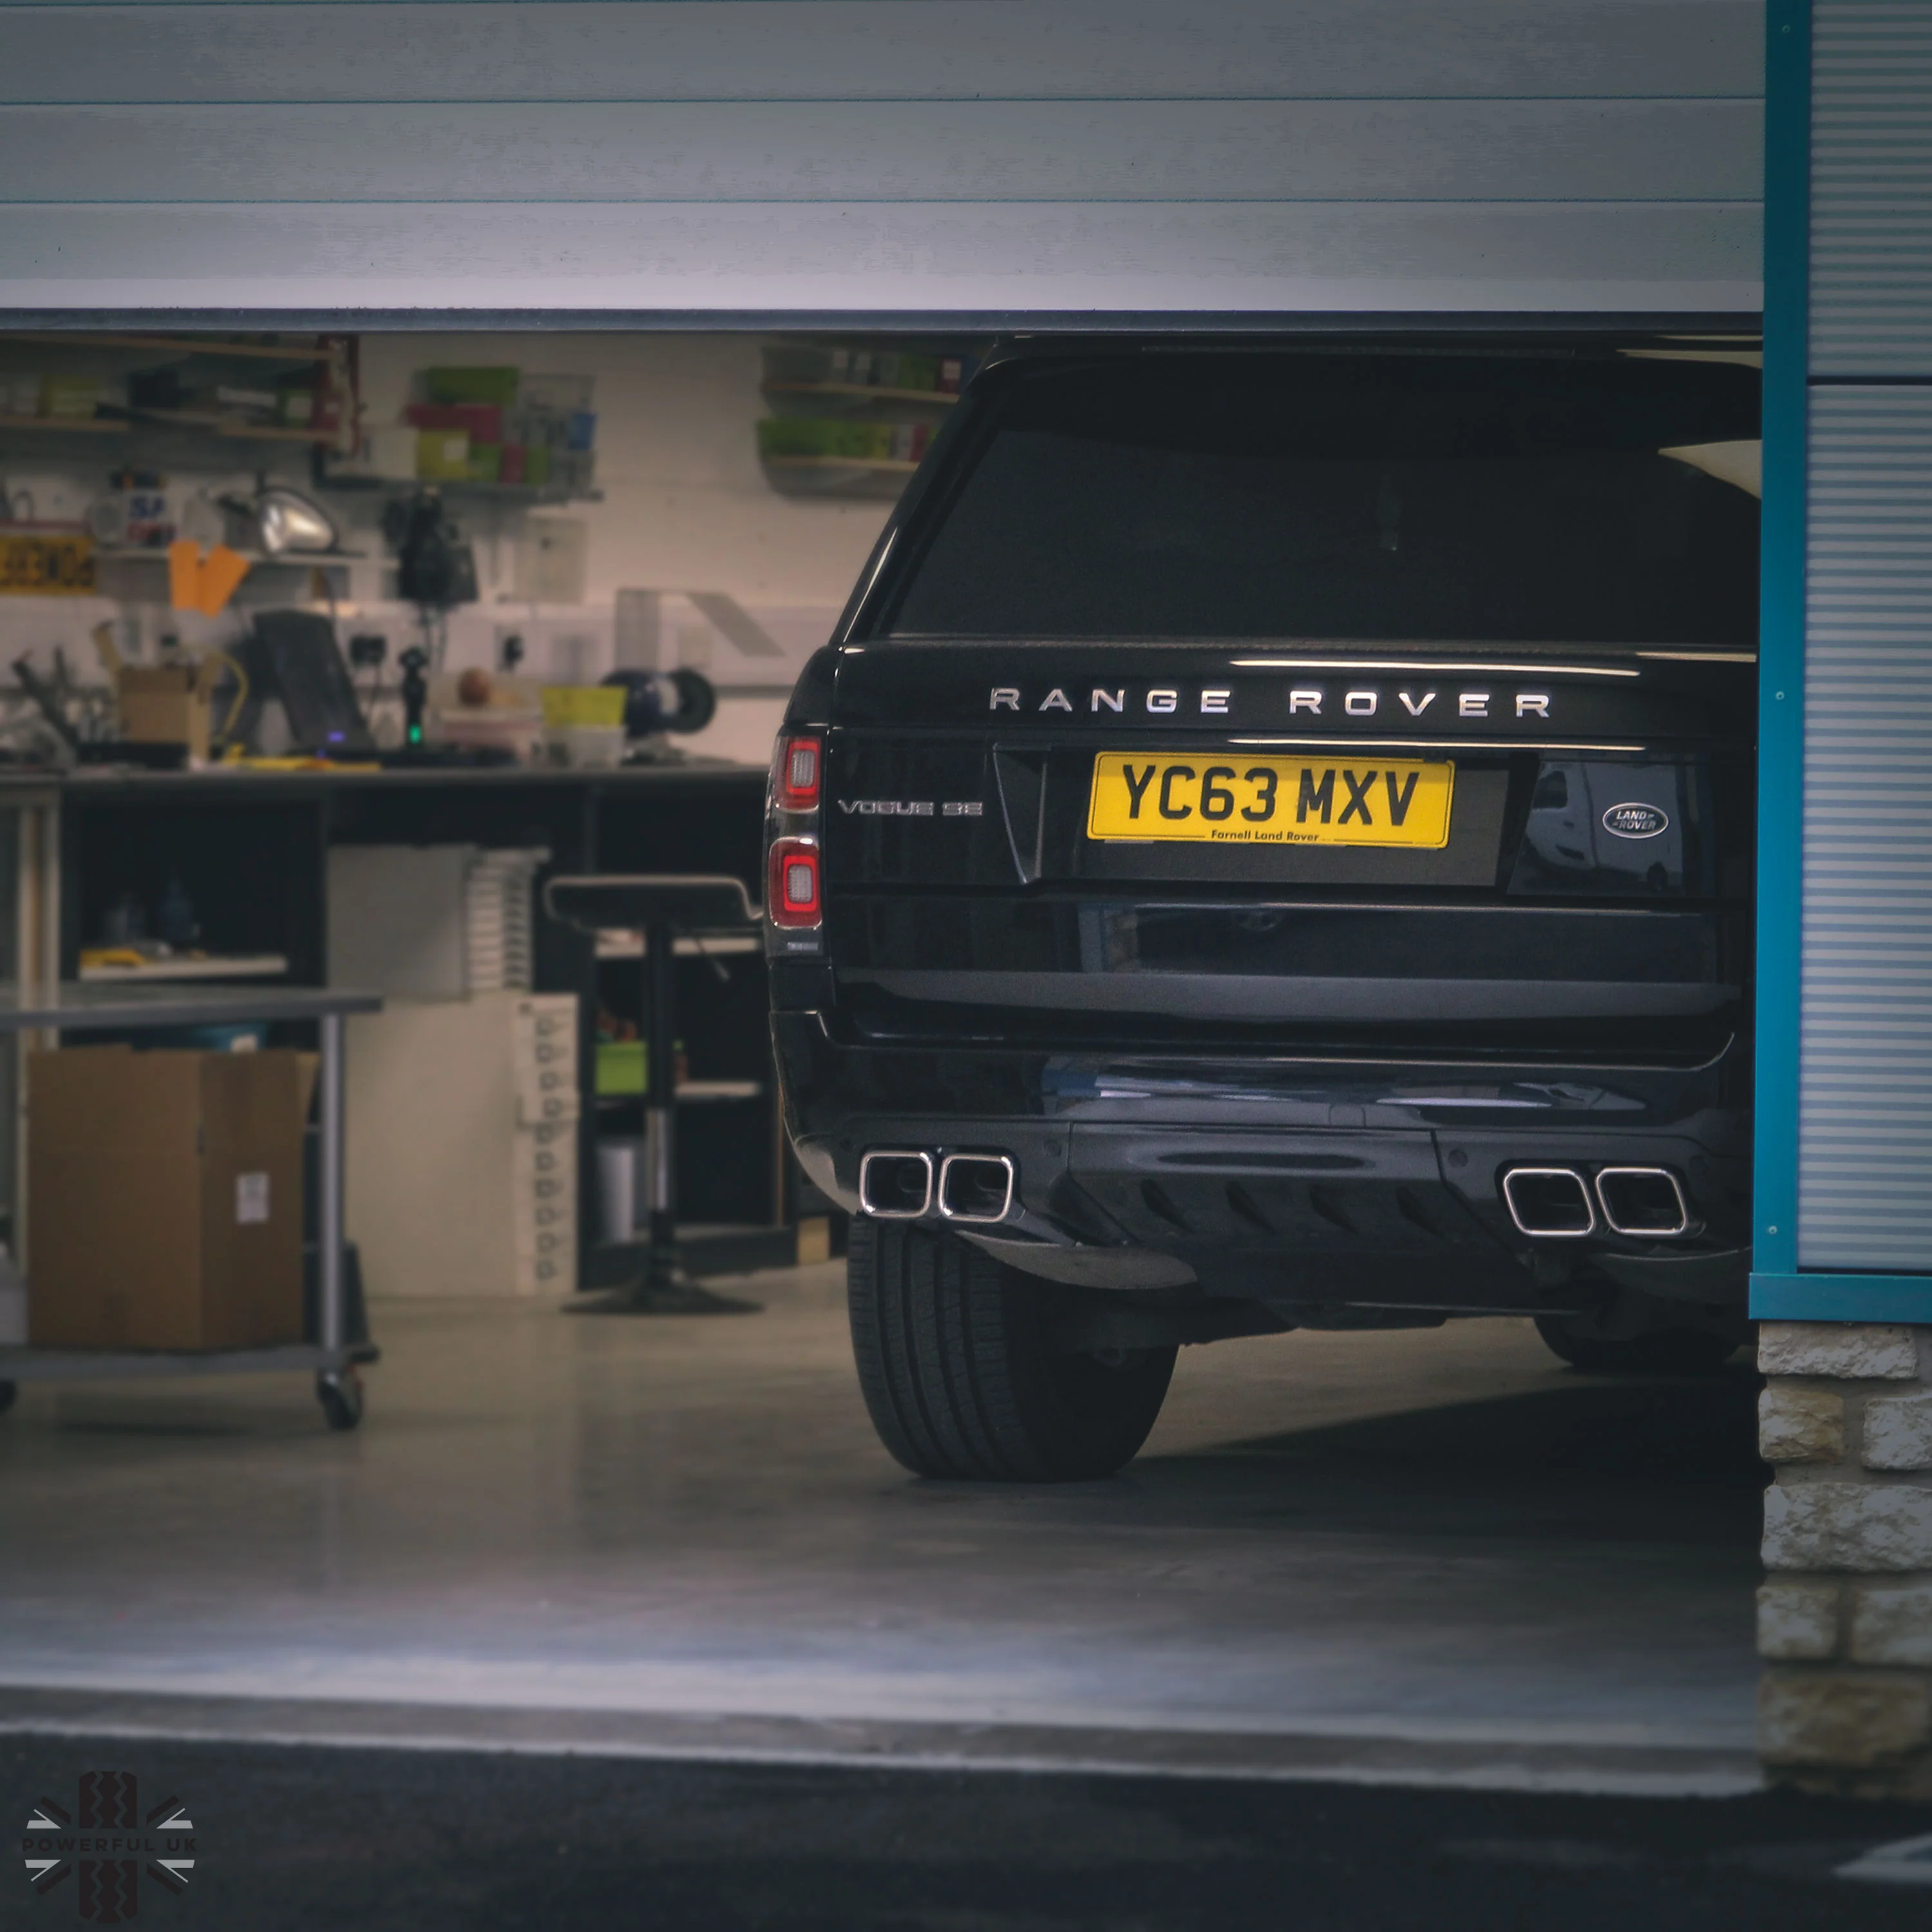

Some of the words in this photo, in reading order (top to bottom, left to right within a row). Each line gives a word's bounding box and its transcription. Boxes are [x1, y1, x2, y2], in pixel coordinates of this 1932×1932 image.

[989, 687, 1231, 714] RANGE
[1289, 690, 1549, 718] ROVER
[837, 799, 934, 816] VOGUE
[942, 802, 983, 816] SE
[1122, 764, 1278, 822] YC63
[1296, 768, 1420, 827] MXV
[1211, 829, 1251, 840] Farnell
[1255, 831, 1283, 841] Land
[1287, 831, 1320, 842] Rover
